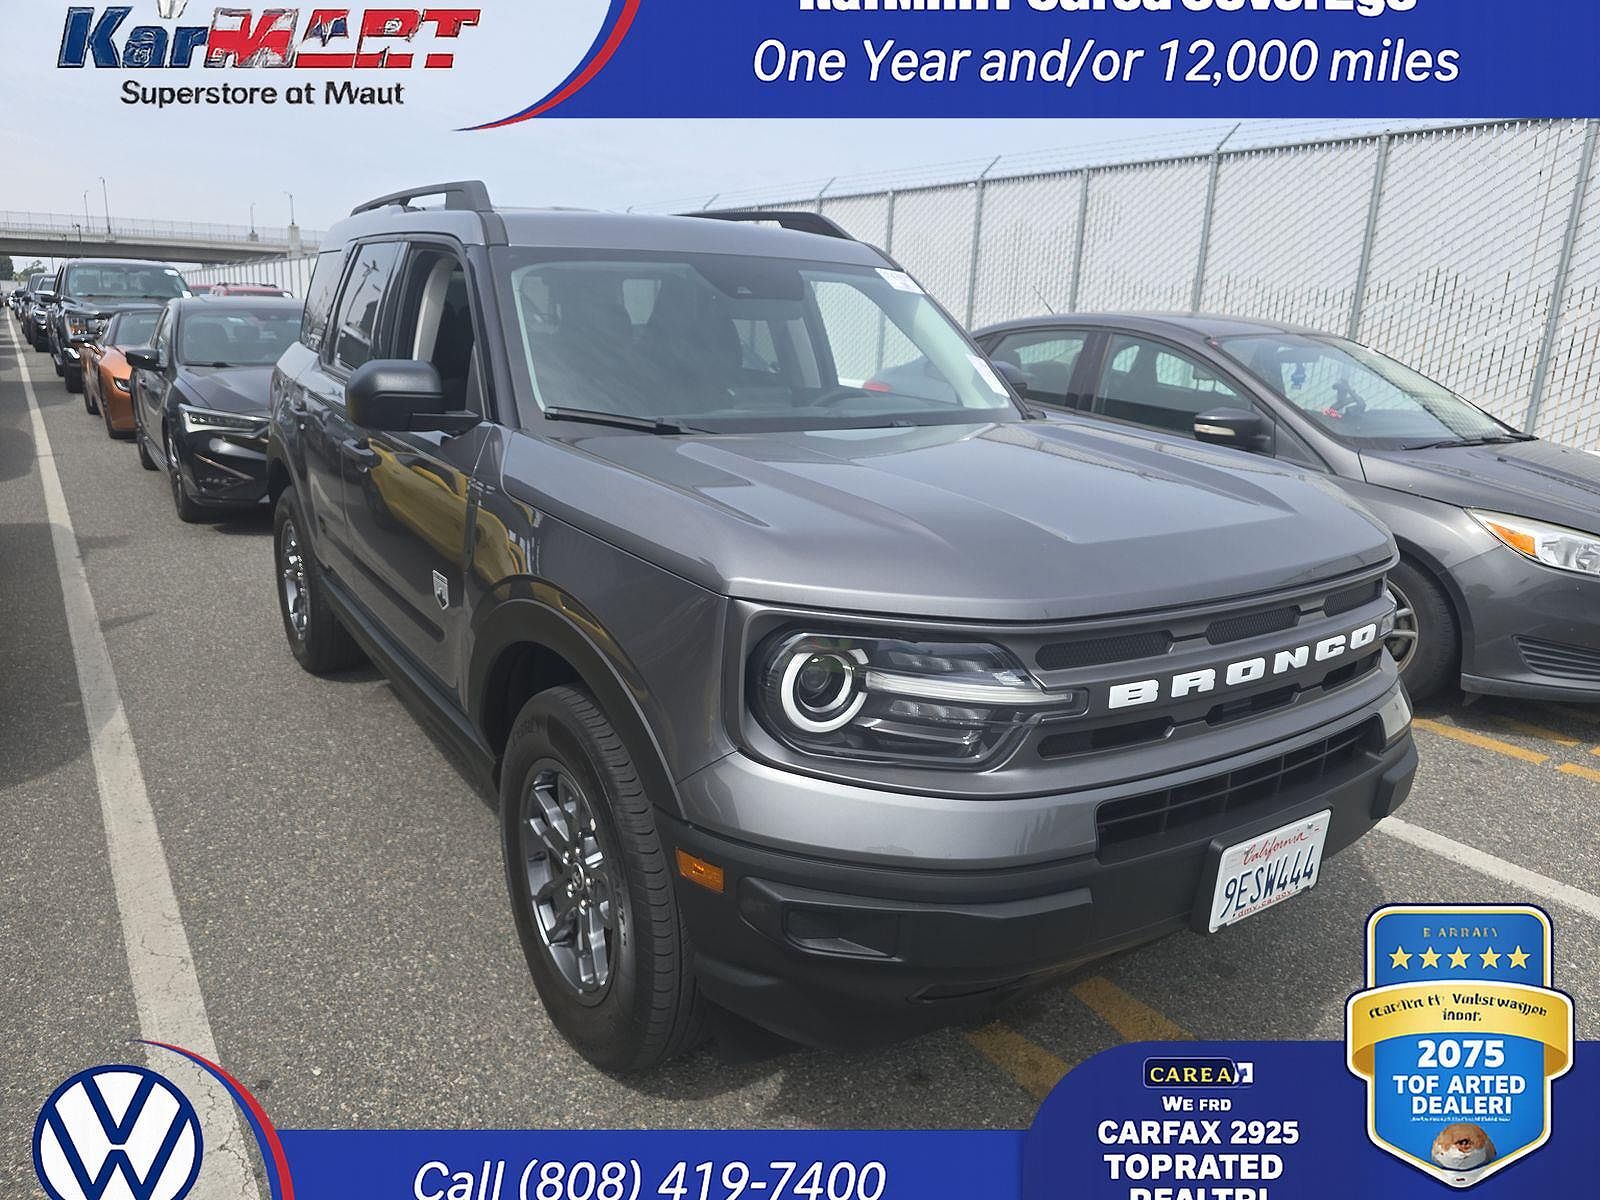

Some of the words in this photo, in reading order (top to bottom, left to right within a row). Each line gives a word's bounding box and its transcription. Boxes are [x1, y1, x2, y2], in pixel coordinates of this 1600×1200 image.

[1108, 623, 1377, 709] BRONCO
[1219, 845, 1314, 918] 9ESW444
[1243, 829, 1310, 866] California
